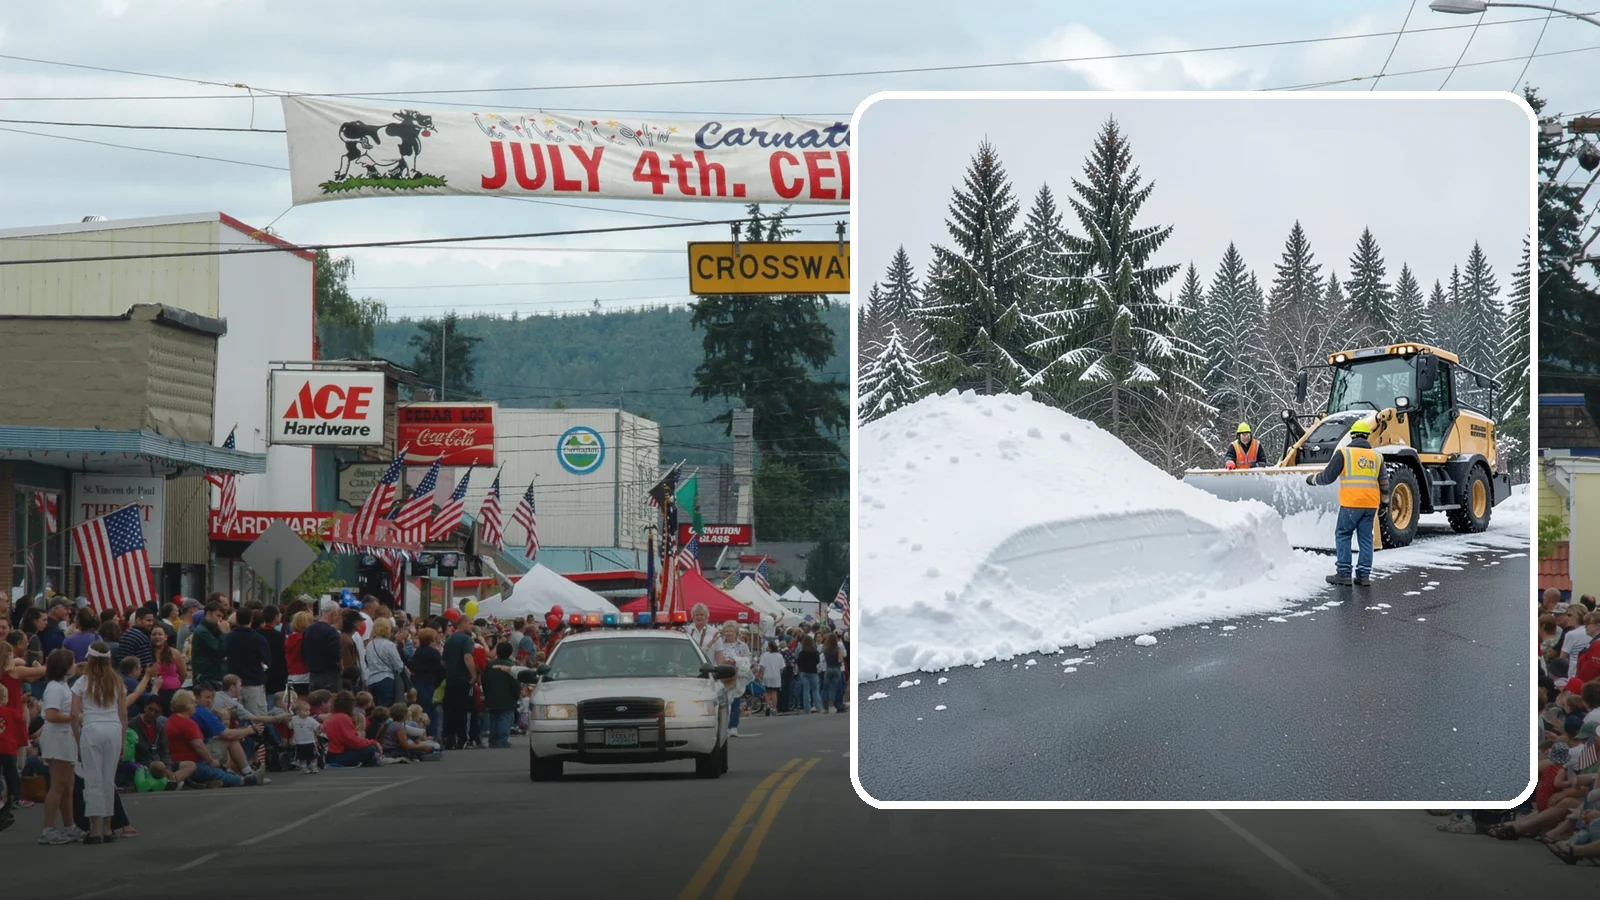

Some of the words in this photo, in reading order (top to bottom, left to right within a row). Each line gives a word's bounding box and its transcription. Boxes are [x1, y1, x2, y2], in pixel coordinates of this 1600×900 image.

[694, 121, 850, 150] Carnat
[481, 141, 605, 193] JULY
[632, 150, 747, 198] 4th.
[696, 254, 850, 280] CROSSWA
[282, 380, 374, 420] ACE
[405, 409, 452, 422] CEDAR
[283, 421, 371, 437] Hardware
[83, 485, 93, 494] St.
[95, 485, 124, 494] Vincent
[126, 485, 136, 494] de
[137, 485, 155, 496] Paul
[688, 526, 741, 535] CRNATION
[699, 535, 730, 544] GLASS
